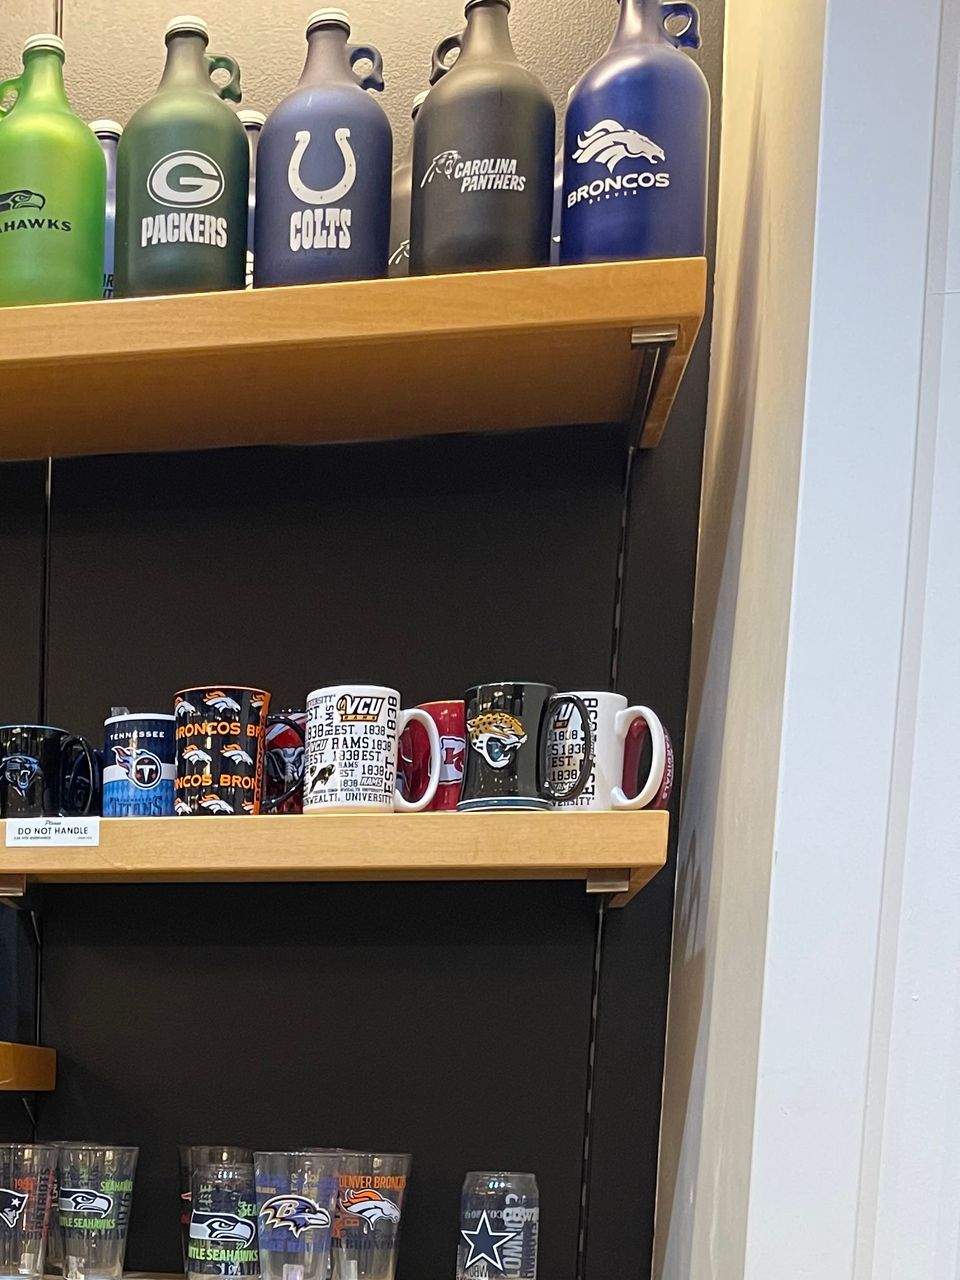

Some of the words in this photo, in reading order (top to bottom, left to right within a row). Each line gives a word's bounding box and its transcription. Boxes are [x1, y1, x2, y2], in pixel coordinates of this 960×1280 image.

[454, 158, 517, 179] CAROLINA
[150, 154, 221, 204] G
[460, 174, 526, 192] PANTHERS
[567, 172, 670, 209] BRONCOS
[141, 213, 228, 248] PACKERS
[290, 209, 352, 252] COLTS
[346, 697, 386, 715] VCU
[325, 705, 334, 736] RAMS
[387, 696, 398, 741] 1838
[110, 731, 165, 741] TENNSSEE
[334, 725, 358, 735] EST.
[364, 725, 386, 735] 1838
[332, 737, 369, 749] RAMS
[372, 740, 391, 751] 1838
[361, 765, 385, 775] 1838
[552, 756, 576, 768] EST.
[384, 753, 394, 794] EST.
[552, 770, 578, 781] 1838
[18, 827, 31, 835] DO
[34, 827, 52, 835] NOT
[73, 1218, 115, 1229] SEAHAWKS
[207, 1249, 258, 1261] SEAHAWKS
